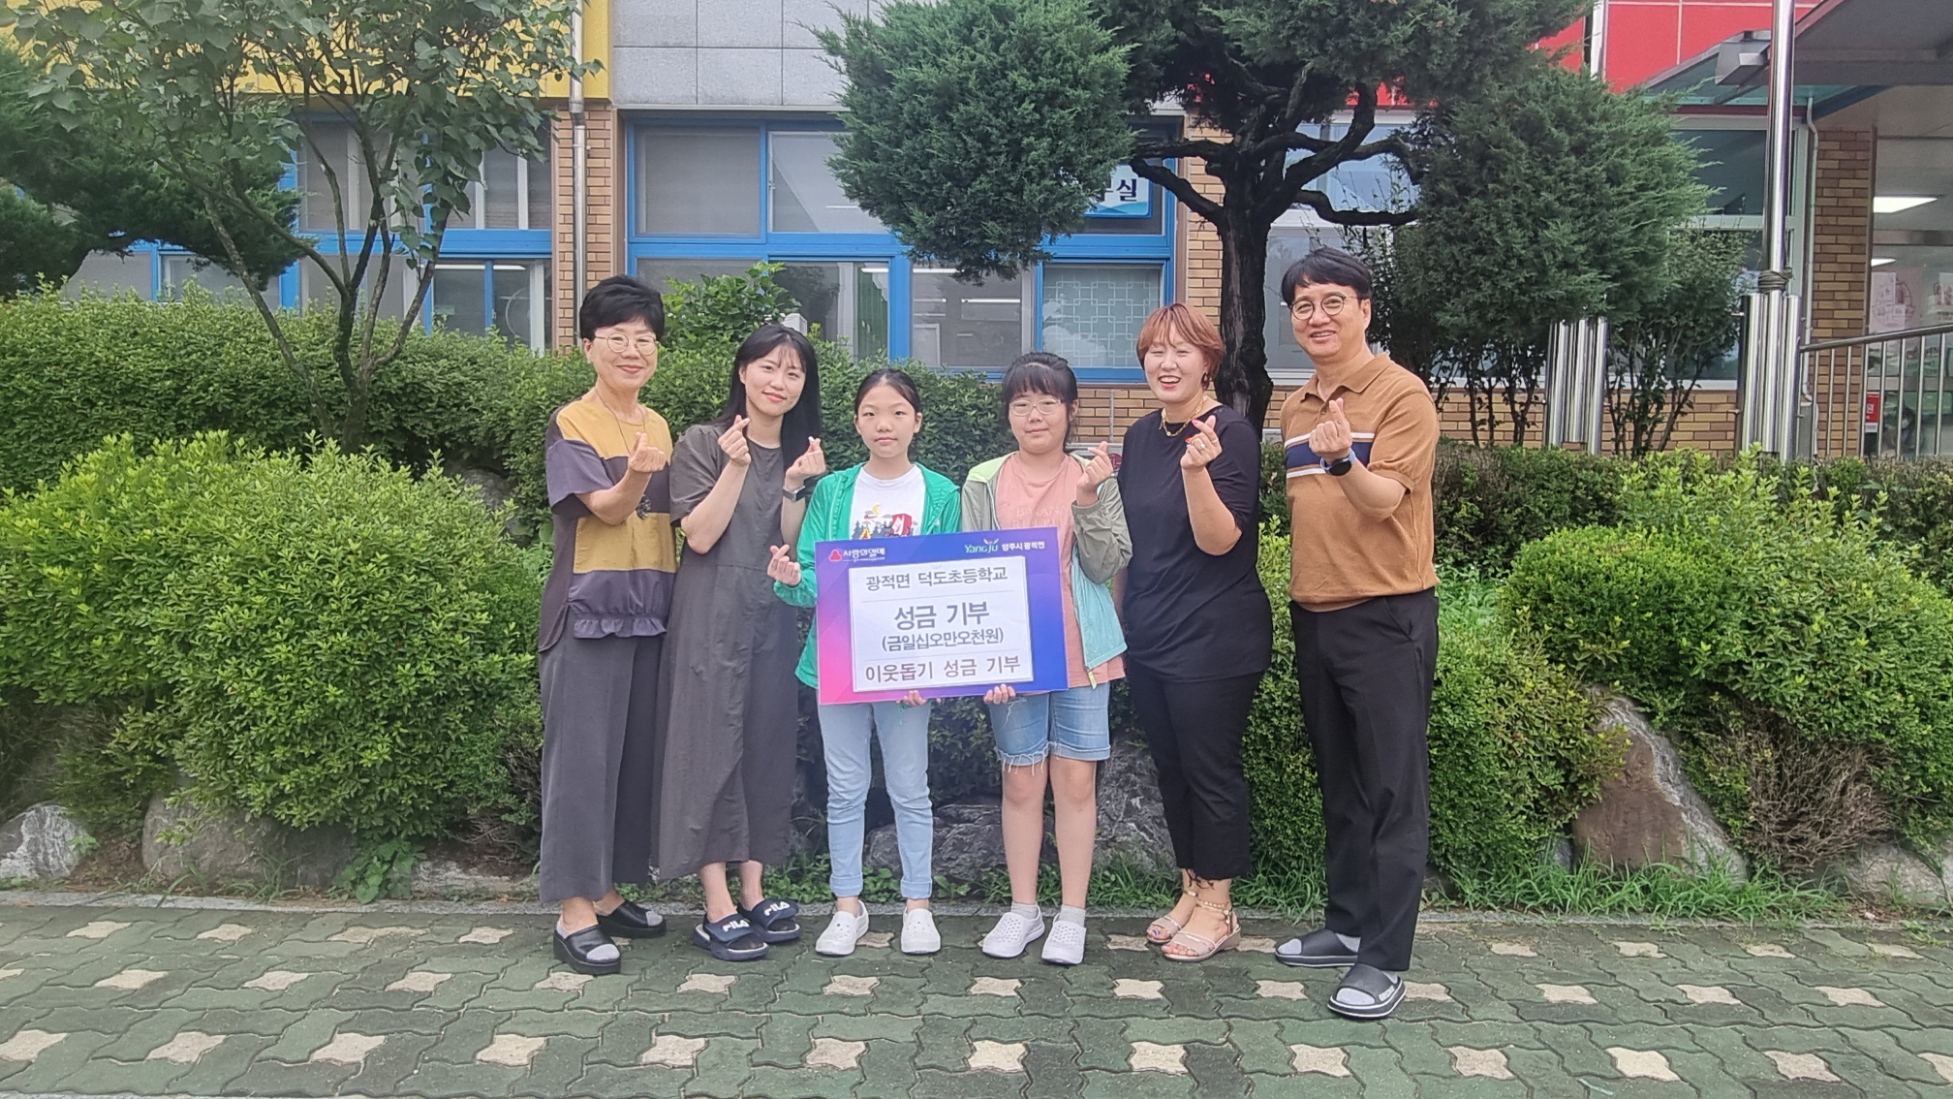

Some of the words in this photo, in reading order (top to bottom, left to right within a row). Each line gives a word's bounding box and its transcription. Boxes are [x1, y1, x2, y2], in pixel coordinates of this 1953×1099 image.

[1001, 542, 1023, 552] 양주시
[866, 573, 910, 591] 광적면
[918, 566, 1008, 587] 덕도초등학교
[894, 605, 937, 631] 성금
[946, 601, 990, 626] 기부
[881, 627, 1004, 652] (금일십오만오천원)
[865, 661, 933, 683] 이웃돕기
[943, 658, 977, 678] 성금
[986, 655, 1021, 674] 기부
[764, 901, 790, 916] FILA
[722, 919, 750, 932] FILA
